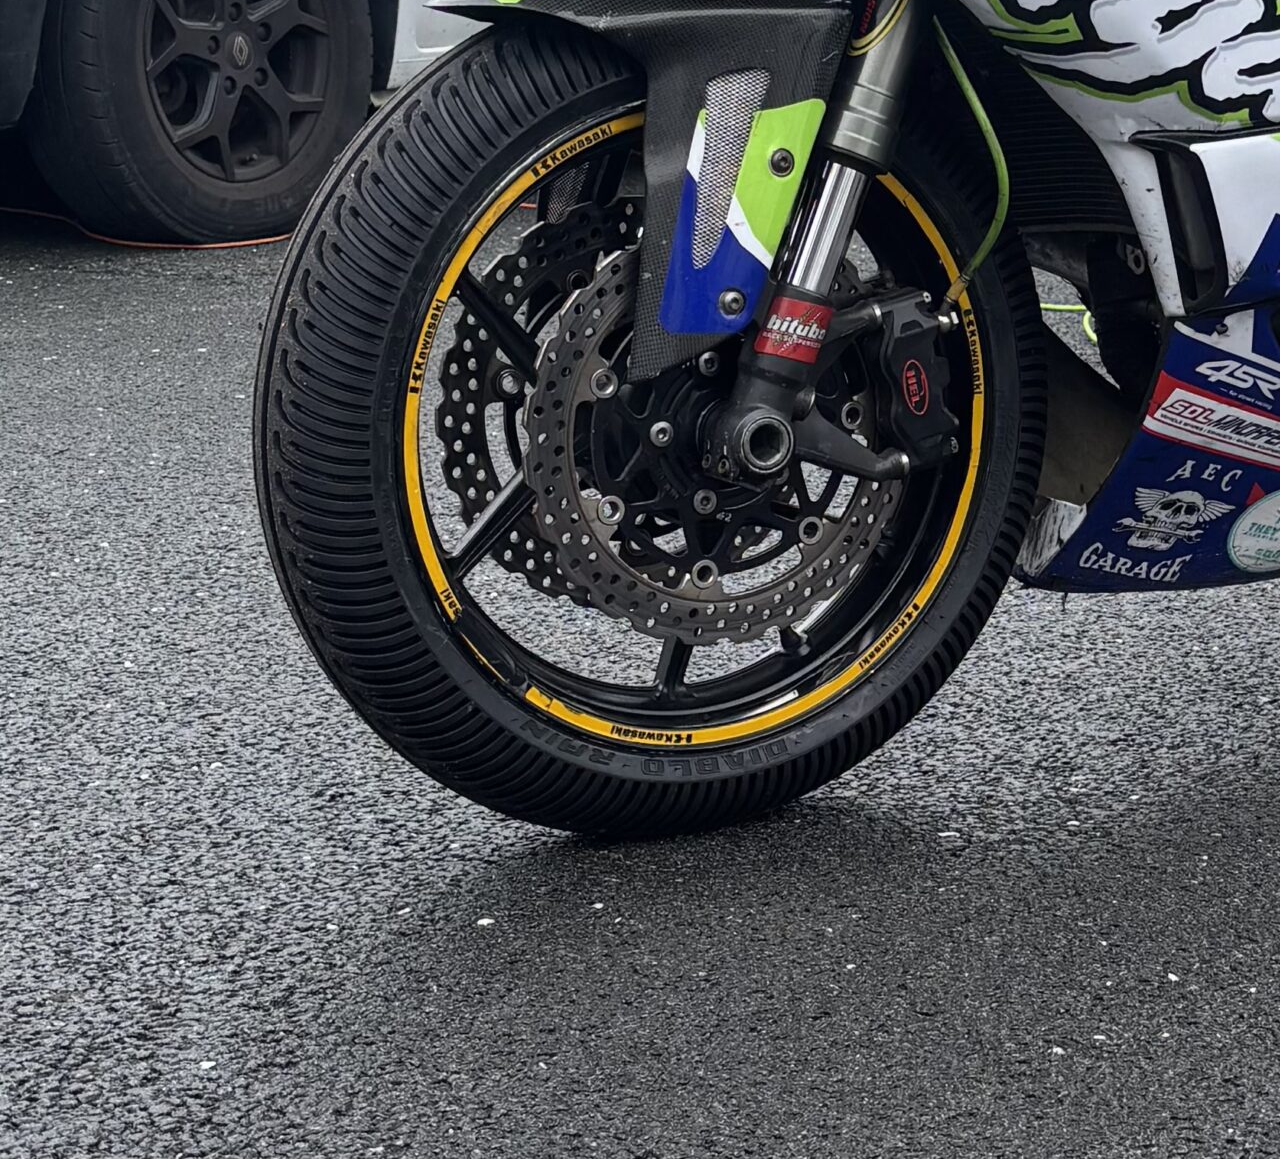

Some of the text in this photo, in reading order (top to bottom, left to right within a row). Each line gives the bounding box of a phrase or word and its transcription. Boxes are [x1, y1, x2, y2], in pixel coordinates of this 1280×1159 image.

[552, 124, 613, 166] Kawasaki
[413, 298, 447, 371] Kawasaki
[766, 314, 826, 340] bitubo
[1163, 399, 1216, 425] SDL
[1078, 542, 1193, 583] GARAGE
[610, 724, 673, 744] Kawasaki
[640, 738, 789, 778] DIABLO
